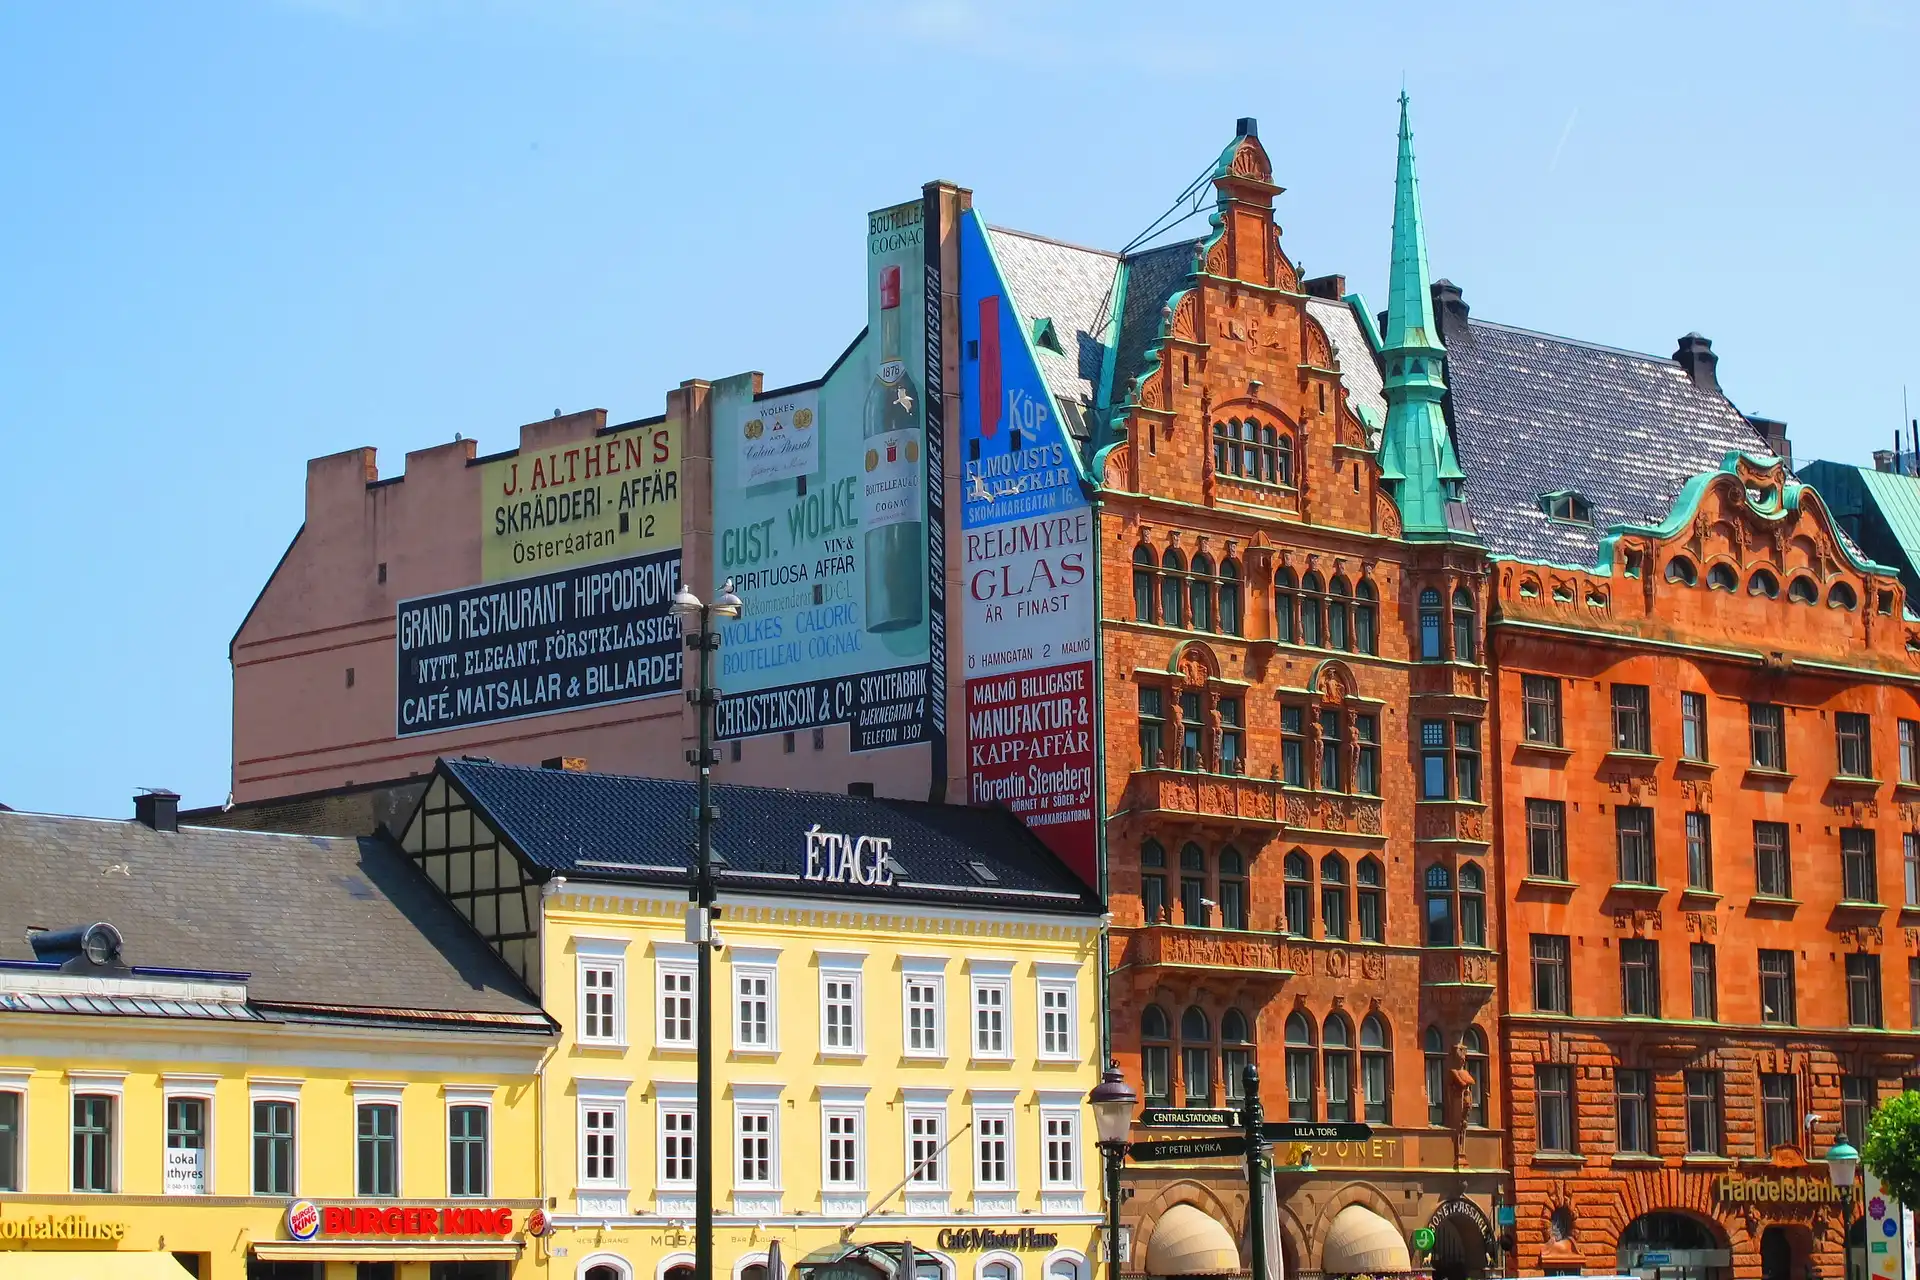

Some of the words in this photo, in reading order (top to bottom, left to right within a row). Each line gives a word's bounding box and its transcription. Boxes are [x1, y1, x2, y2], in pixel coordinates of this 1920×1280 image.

[871, 228, 924, 255] COGNAC
[882, 364, 900, 379] 1878
[760, 403, 795, 417] WOLKES
[1008, 388, 1048, 441] KÖP
[504, 464, 523, 496] J.
[531, 428, 669, 491] ALTHÉN'S
[495, 486, 600, 535] SKRÄDDERI
[619, 469, 677, 511] AFFÄR
[875, 499, 908, 513] COGNAC
[968, 492, 1056, 523] SKOMAKAREGATAN
[722, 517, 779, 569] GUST.
[788, 476, 859, 548] WOLKE
[967, 514, 1087, 563] REIJMYRE
[513, 528, 615, 564] Östergatan
[639, 515, 655, 539] 12
[726, 564, 808, 593] SPIRITUOSA
[814, 554, 855, 579] AFFÄR
[930, 516, 944, 600] GENOM
[970, 552, 1085, 602] GLAS
[401, 603, 452, 650] GRAND
[459, 581, 566, 640] RESTAURANT
[574, 559, 680, 618] HIPPODROME
[985, 603, 1003, 623] ÄR
[1018, 595, 1069, 619] FINAST
[722, 616, 783, 647] WOLKES
[796, 602, 859, 634] CALORIC
[418, 653, 460, 684] NYTT,
[464, 639, 540, 676] ELEGANT,
[545, 615, 682, 662] FÖRSTKLASSIGT
[723, 640, 802, 676] BOUTELLEAU
[809, 629, 863, 660] COGNAC
[982, 648, 1033, 667] HAMNGATAN
[1043, 644, 1051, 658] 2
[1062, 638, 1090, 654] MALMÖ
[860, 668, 928, 704] SKYLTFABRIK
[931, 608, 945, 735] ANNONSERA
[973, 678, 1016, 705] MALMÖ
[1021, 669, 1085, 698] BILLIGASTE
[457, 673, 561, 717] MATSALAR
[566, 676, 580, 698] &
[716, 686, 816, 737] CHRISTENSON
[818, 688, 830, 722] &
[860, 703, 914, 727] DJEKNEGATAN
[916, 697, 925, 719] 4
[862, 728, 897, 746] TELEFON
[903, 723, 922, 741] 1307
[972, 731, 1090, 767] KAPP-AFFÄR
[973, 771, 1026, 803] Florentin
[1029, 761, 1091, 799] Steneberg
[1011, 798, 1037, 812] HÖRNET
[1041, 796, 1048, 809] AF
[1026, 808, 1091, 827] SKOMAKAREGATORNA
[804, 823, 893, 886] ÉTAGE
[1153, 1113, 1224, 1123] CENTRALSTATIONEN
[1294, 1128, 1314, 1136] LILLA
[1316, 1128, 1337, 1136] TORG
[169, 1152, 197, 1165] Lokal
[1169, 1145, 1191, 1154] PETRI
[1194, 1143, 1222, 1153] KYRKA
[1719, 1175, 1863, 1202] Handelsbankn
[292, 1205, 314, 1224] BURGER
[294, 1211, 317, 1233] KING
[324, 1207, 440, 1235] BURGER
[444, 1207, 513, 1235] KING
[731, 1236, 746, 1244] BAR
[938, 1228, 972, 1249] Café
[1019, 1228, 1058, 1248] Hans
